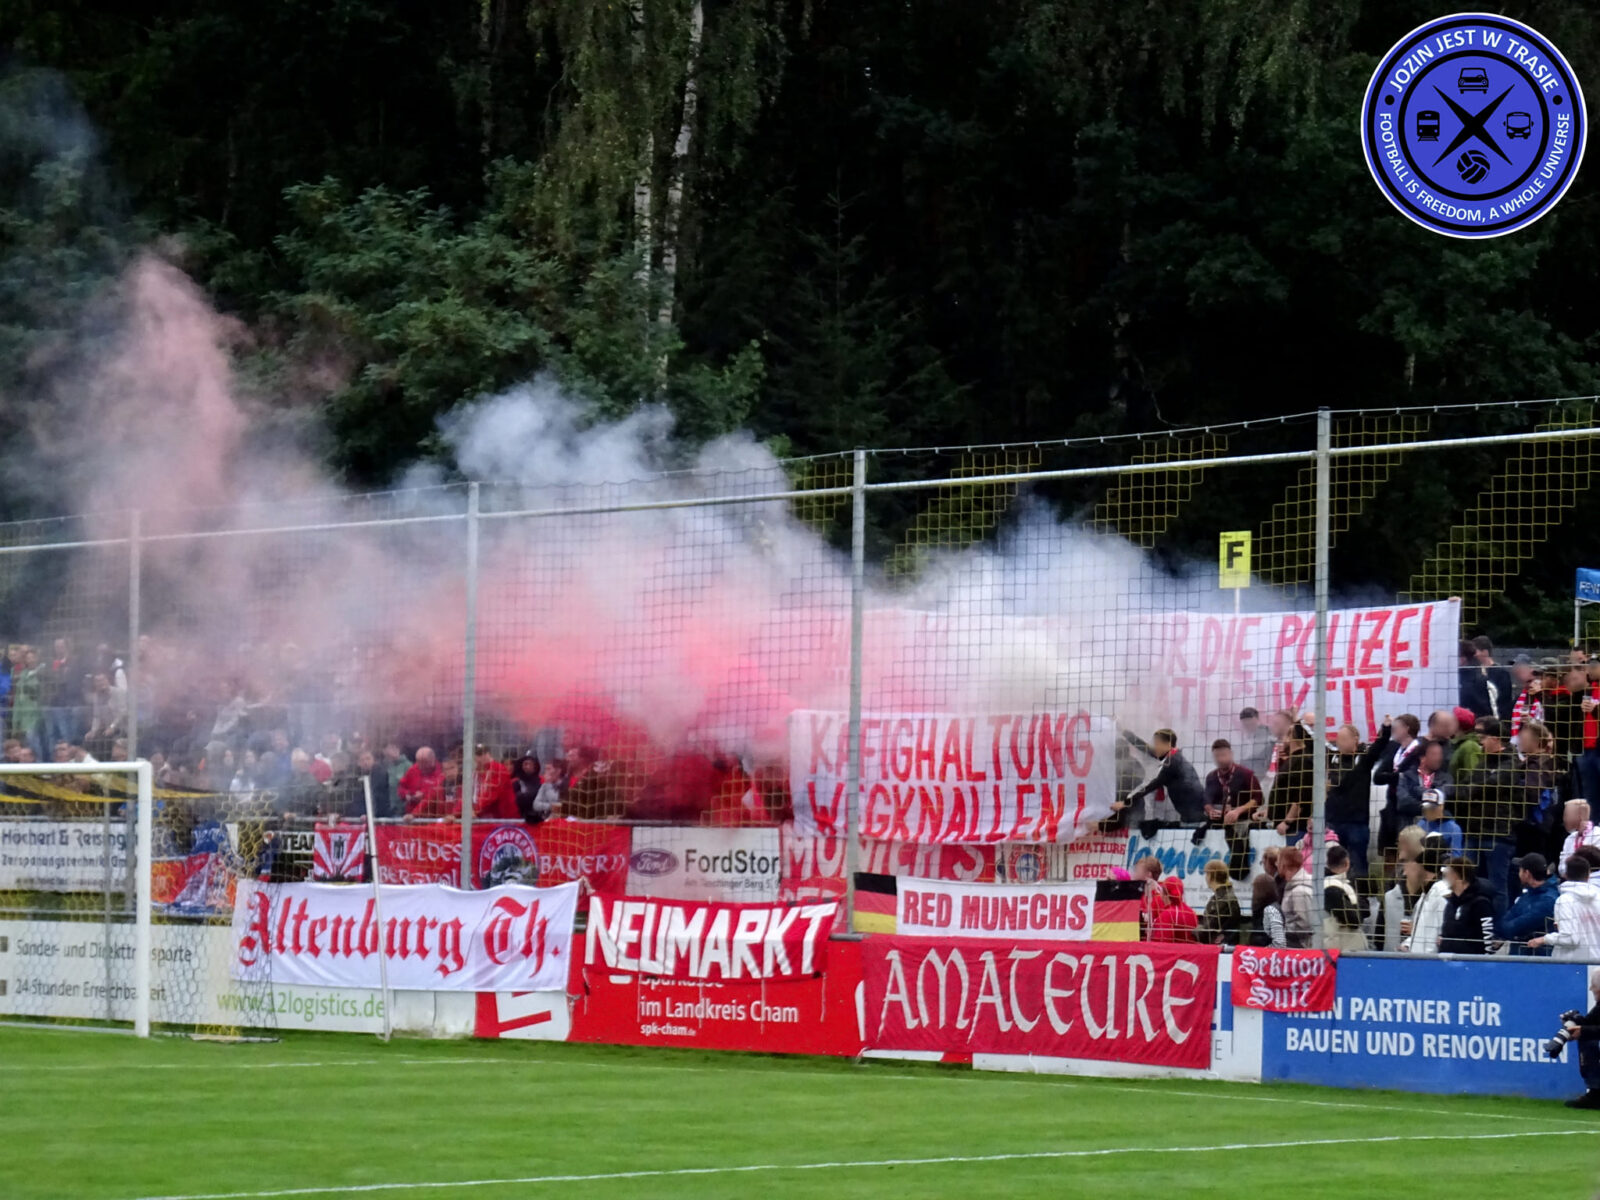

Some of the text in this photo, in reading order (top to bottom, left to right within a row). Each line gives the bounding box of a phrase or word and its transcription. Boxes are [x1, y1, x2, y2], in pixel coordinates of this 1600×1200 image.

[1226, 541, 1245, 569] F
[1199, 615, 1261, 680] DIE
[1273, 604, 1434, 678] POLIZEI
[540, 854, 627, 878] BAYERN
[684, 848, 780, 876] FordStor
[1073, 863, 1115, 879] GEGE
[903, 890, 953, 928] RED
[238, 890, 465, 978] Altenburg
[584, 895, 839, 979] NEUMARKT
[64, 941, 86, 958] und
[1238, 948, 1326, 978] Sektion
[876, 946, 1200, 1045] AMATEURE
[1246, 977, 1312, 1008] Suff
[640, 995, 799, 1023] im Landkreis Cham
[1350, 997, 1451, 1025] PARTNER
[1458, 995, 1502, 1027] FÜR
[1286, 1027, 1359, 1054] BAUEN
[1366, 1031, 1415, 1057] UND
